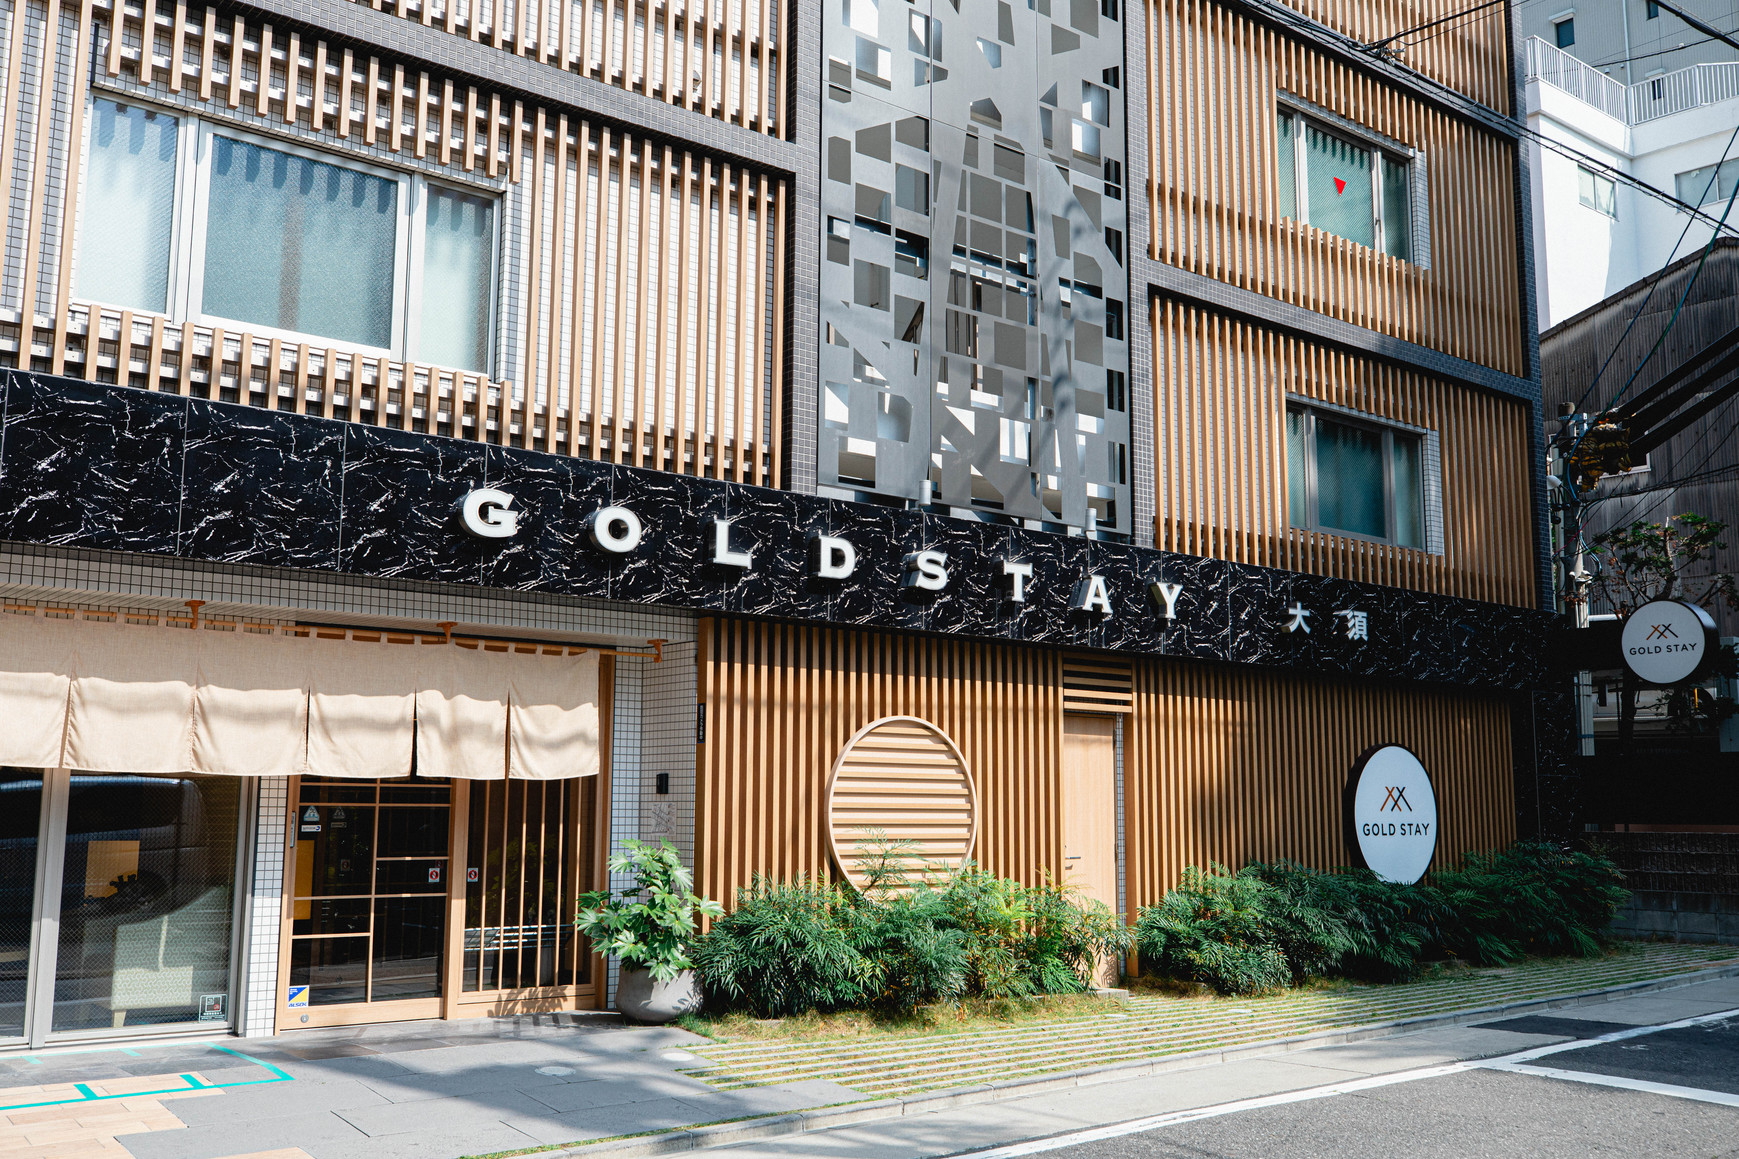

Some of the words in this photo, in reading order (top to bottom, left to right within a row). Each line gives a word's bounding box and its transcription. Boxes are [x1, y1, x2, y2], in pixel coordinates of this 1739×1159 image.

[1285, 601, 1368, 641] 大須
[1629, 645, 1662, 656] GOLD
[1666, 642, 1697, 653] STAY
[1362, 822, 1396, 836] GOLD
[1400, 822, 1430, 836] STAY
